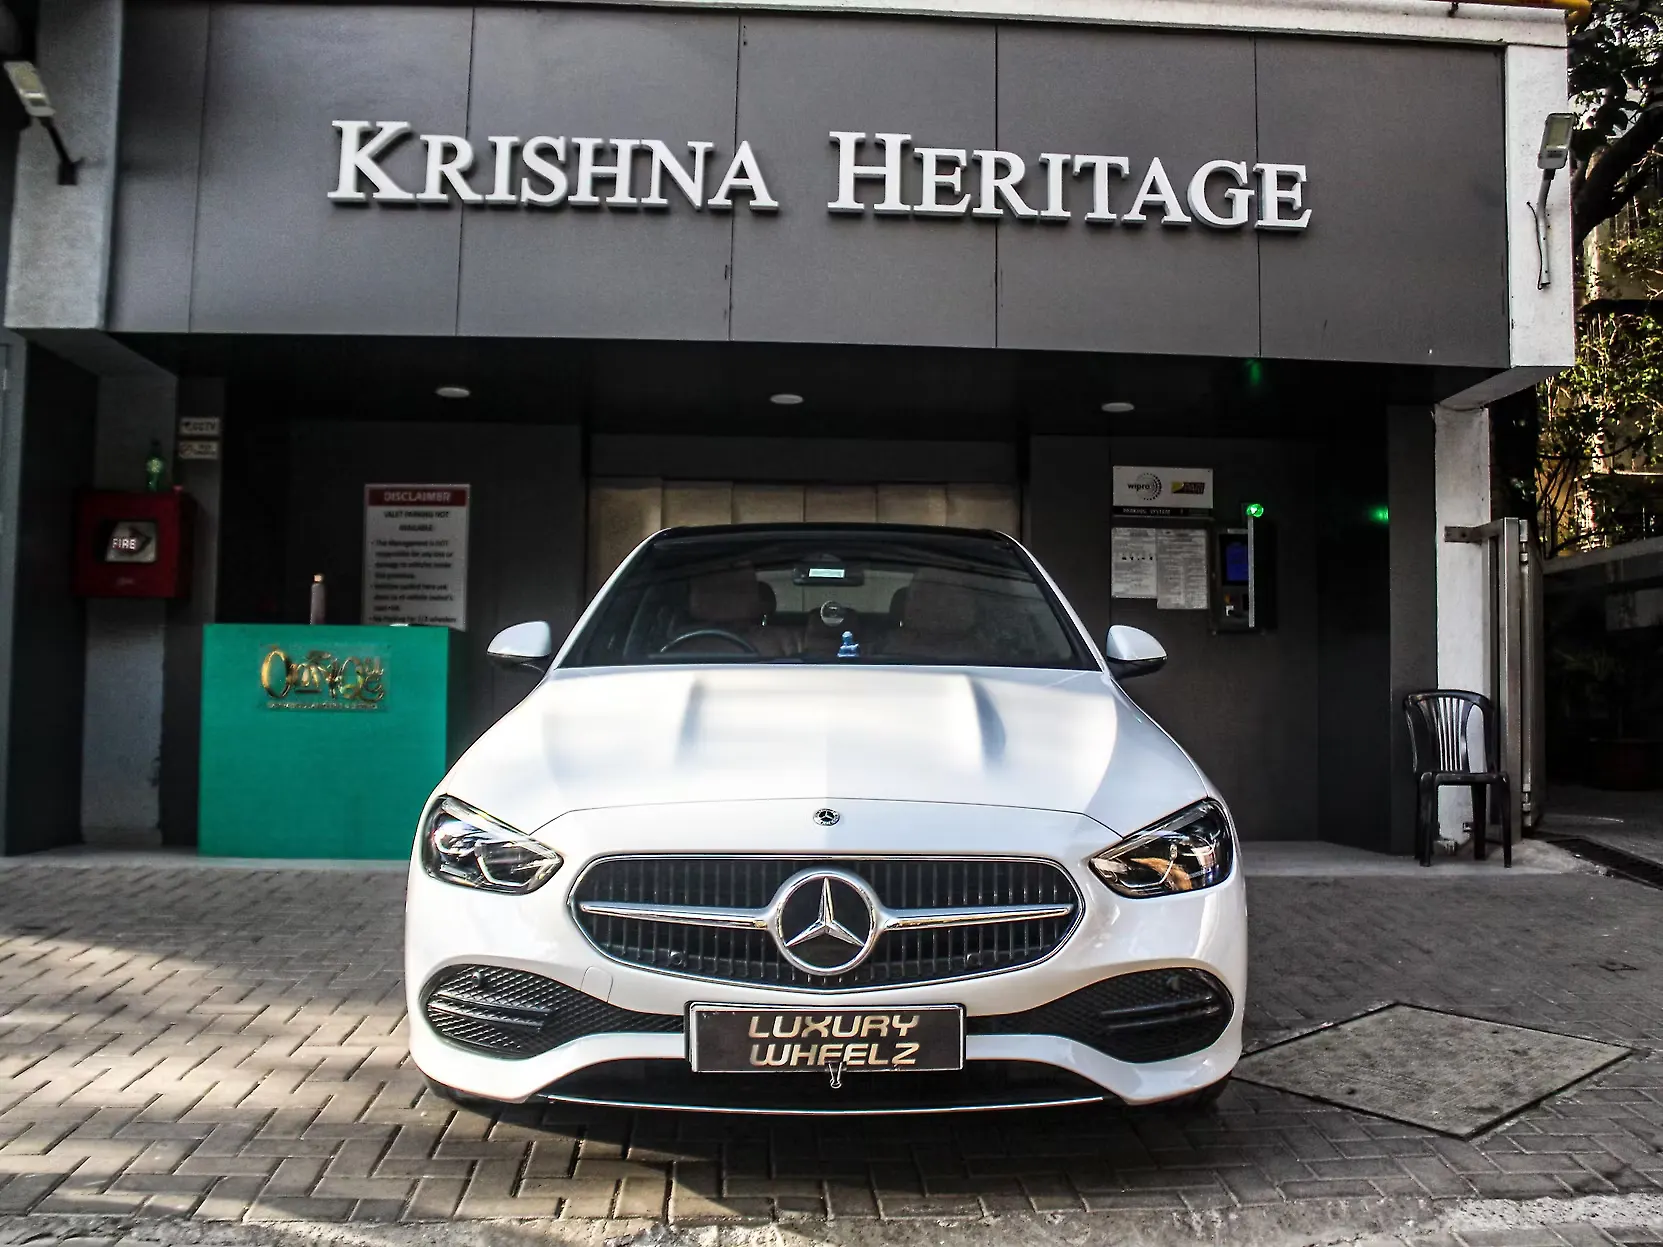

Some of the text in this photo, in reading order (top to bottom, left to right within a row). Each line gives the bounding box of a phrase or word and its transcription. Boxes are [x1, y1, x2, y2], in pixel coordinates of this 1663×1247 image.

[327, 120, 1311, 229] KRISHNA HERITAGE
[383, 490, 452, 503] DISCLAIMER
[1127, 483, 1151, 492] wipro
[112, 538, 137, 550] FIRE
[748, 1014, 920, 1038] LUXURY
[749, 1042, 920, 1066] WHEELZ
